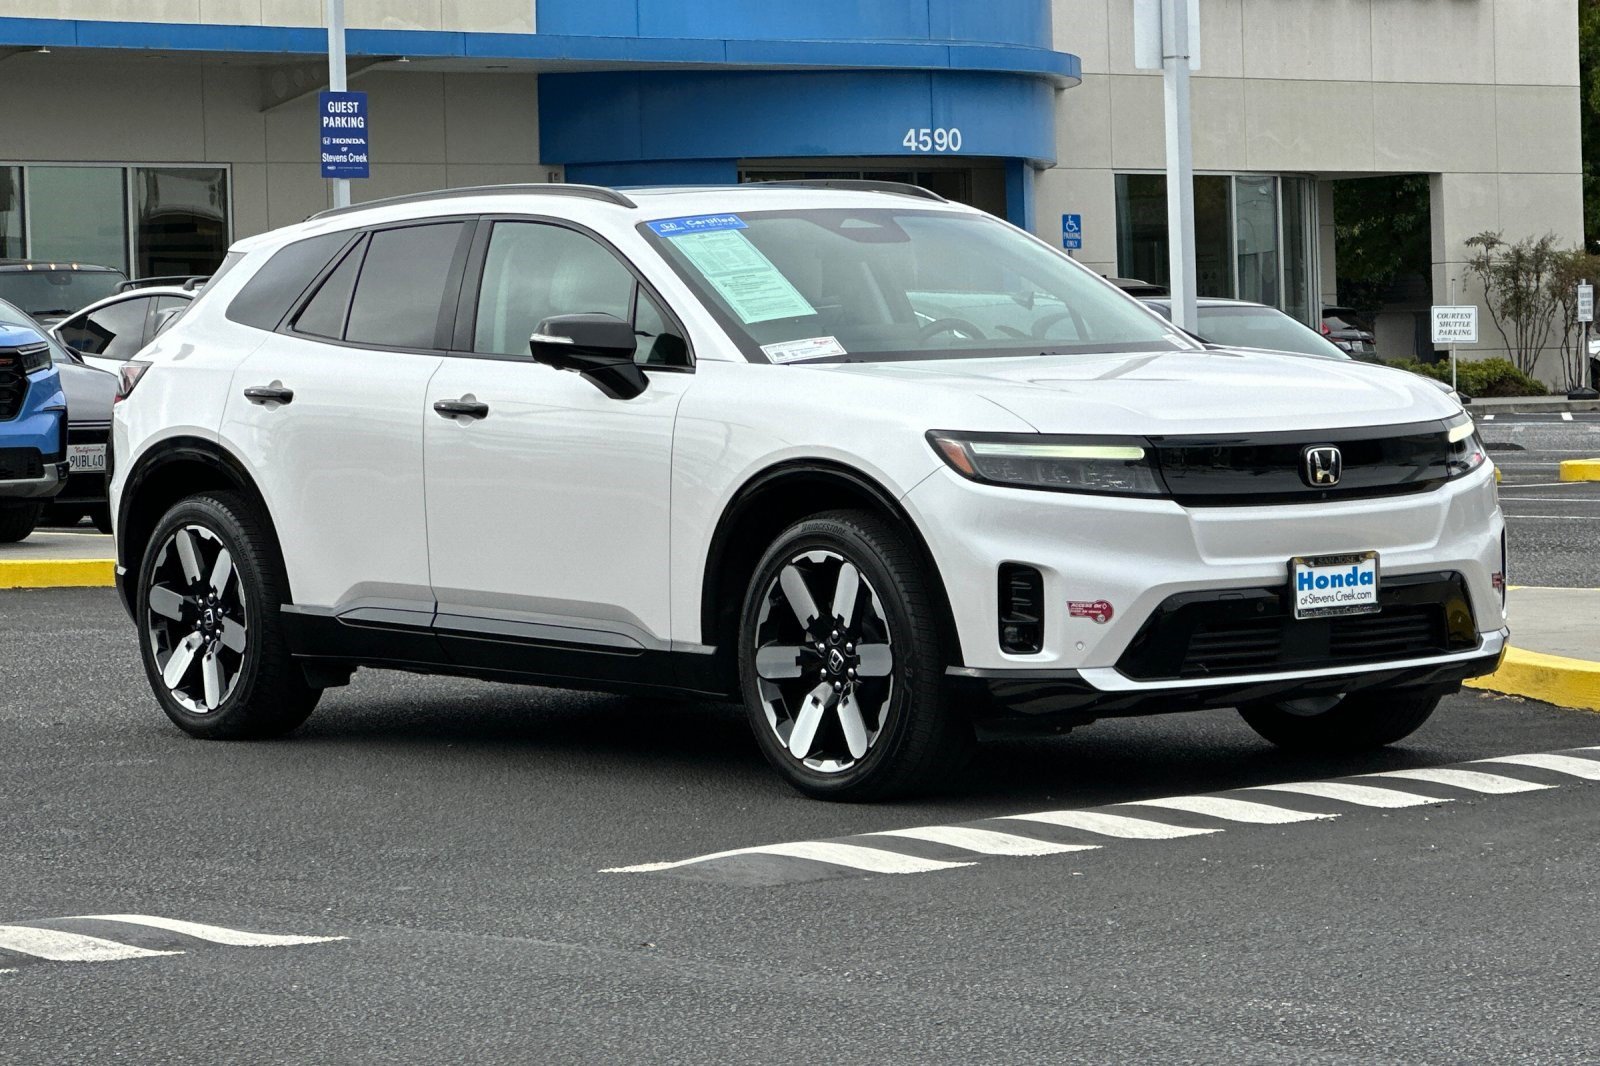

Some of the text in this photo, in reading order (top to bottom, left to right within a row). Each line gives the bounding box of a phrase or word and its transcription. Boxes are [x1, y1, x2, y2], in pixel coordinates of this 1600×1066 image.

[327, 101, 359, 113] GUEST
[323, 116, 364, 128] PARKING
[902, 127, 962, 152] 4590
[322, 152, 367, 163] Stevens Creek
[686, 216, 736, 226] Certified
[1436, 312, 1472, 320] COURTESY
[1439, 320, 1472, 328] SHUTTLE
[69, 454, 106, 468] 9UBL40
[801, 522, 847, 537] BRIDGESTONE
[1298, 566, 1373, 591] Honda
[1300, 588, 1372, 605] of Stevens Creek.com
